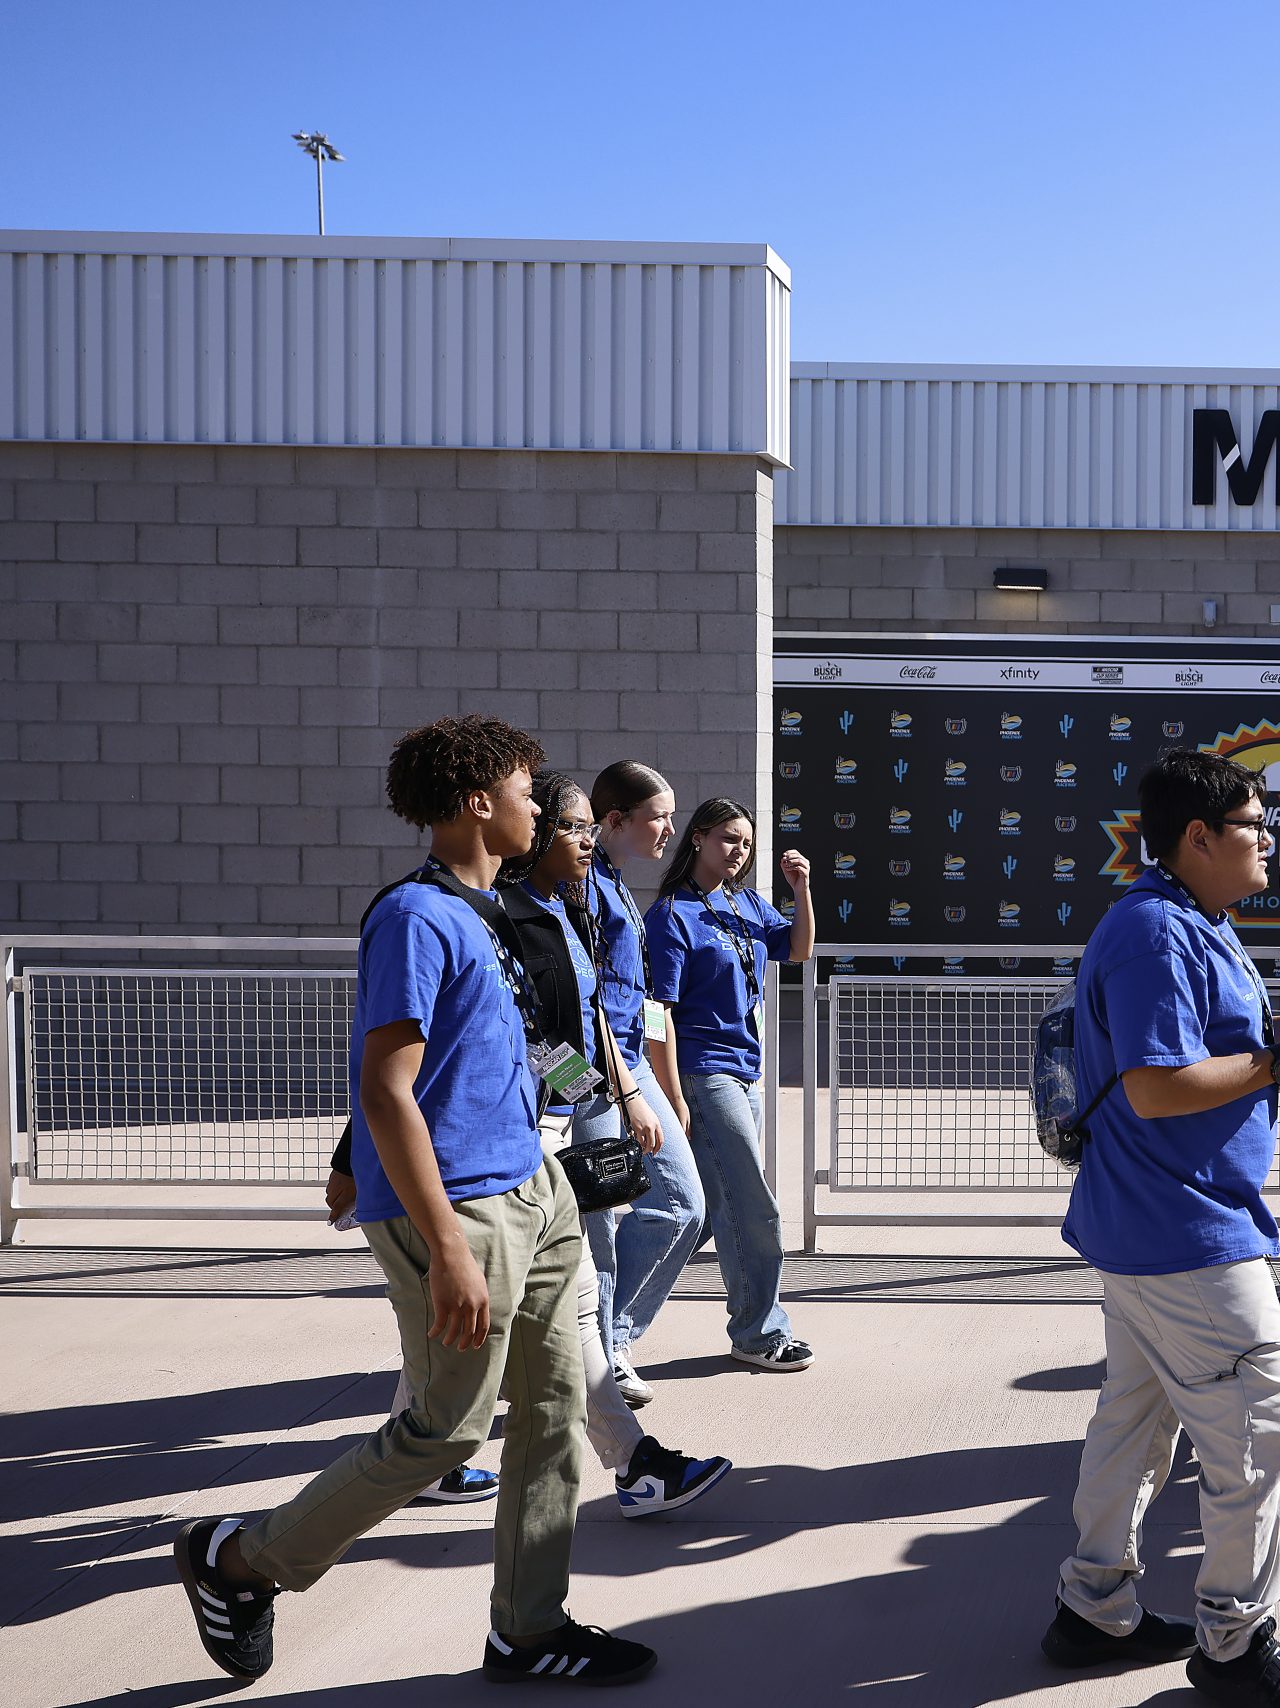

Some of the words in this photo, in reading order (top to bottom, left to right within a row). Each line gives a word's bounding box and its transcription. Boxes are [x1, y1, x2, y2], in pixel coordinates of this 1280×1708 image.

[814, 667, 842, 677] BUSCH
[1000, 666, 1040, 680] xfinity
[1175, 673, 1203, 683] BUSCH
